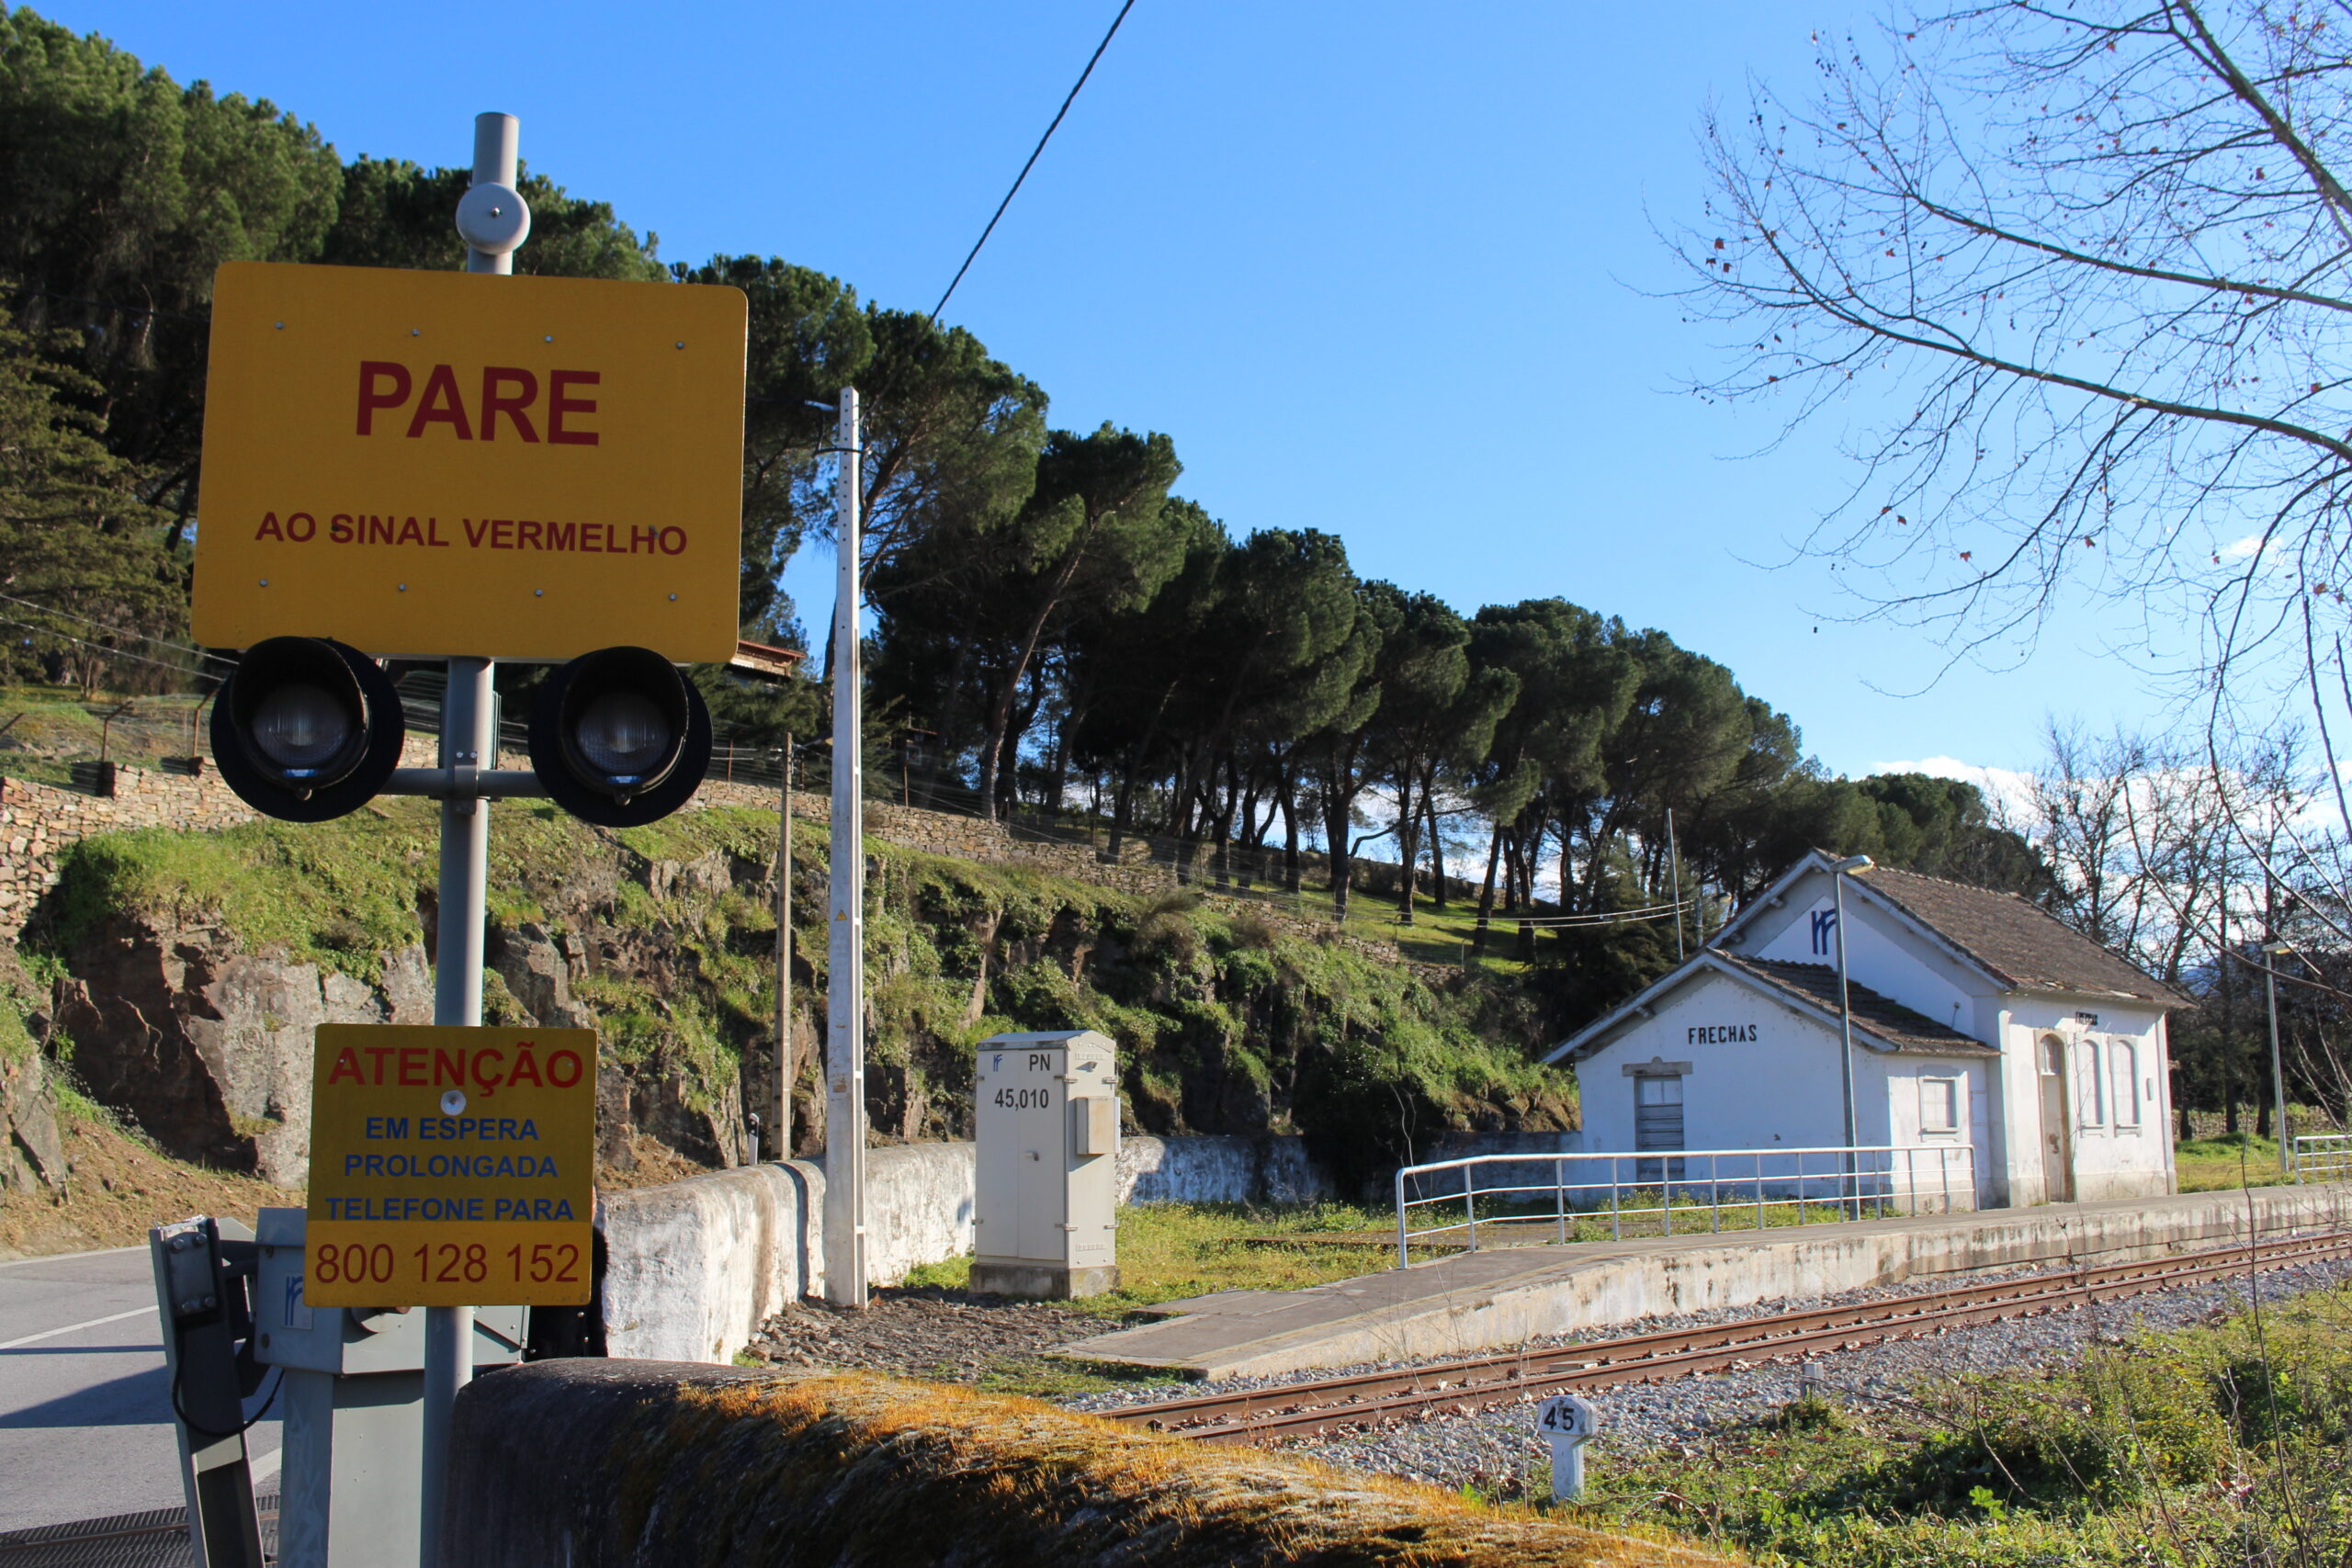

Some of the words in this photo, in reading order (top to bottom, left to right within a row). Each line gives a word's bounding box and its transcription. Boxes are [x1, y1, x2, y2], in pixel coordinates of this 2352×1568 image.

[356, 361, 600, 446] PARE
[255, 512, 316, 542] AO
[330, 514, 449, 547] SINAL
[463, 519, 686, 555] VERMELHO
[1688, 1024, 1757, 1044] FRECHAS
[328, 1042, 582, 1097] ATENÇÃO
[1029, 1053, 1051, 1071] PN
[995, 1089, 1049, 1111] 45,010
[367, 1117, 408, 1139] EM
[419, 1118, 538, 1140] ESPERA
[345, 1155, 558, 1178] PROLONGADA
[325, 1198, 483, 1220] TELEFONE
[495, 1199, 573, 1220] PARA
[316, 1244, 393, 1283] 800
[414, 1244, 487, 1282] 128
[507, 1244, 578, 1282] 152
[1544, 1405, 1575, 1431] 45
